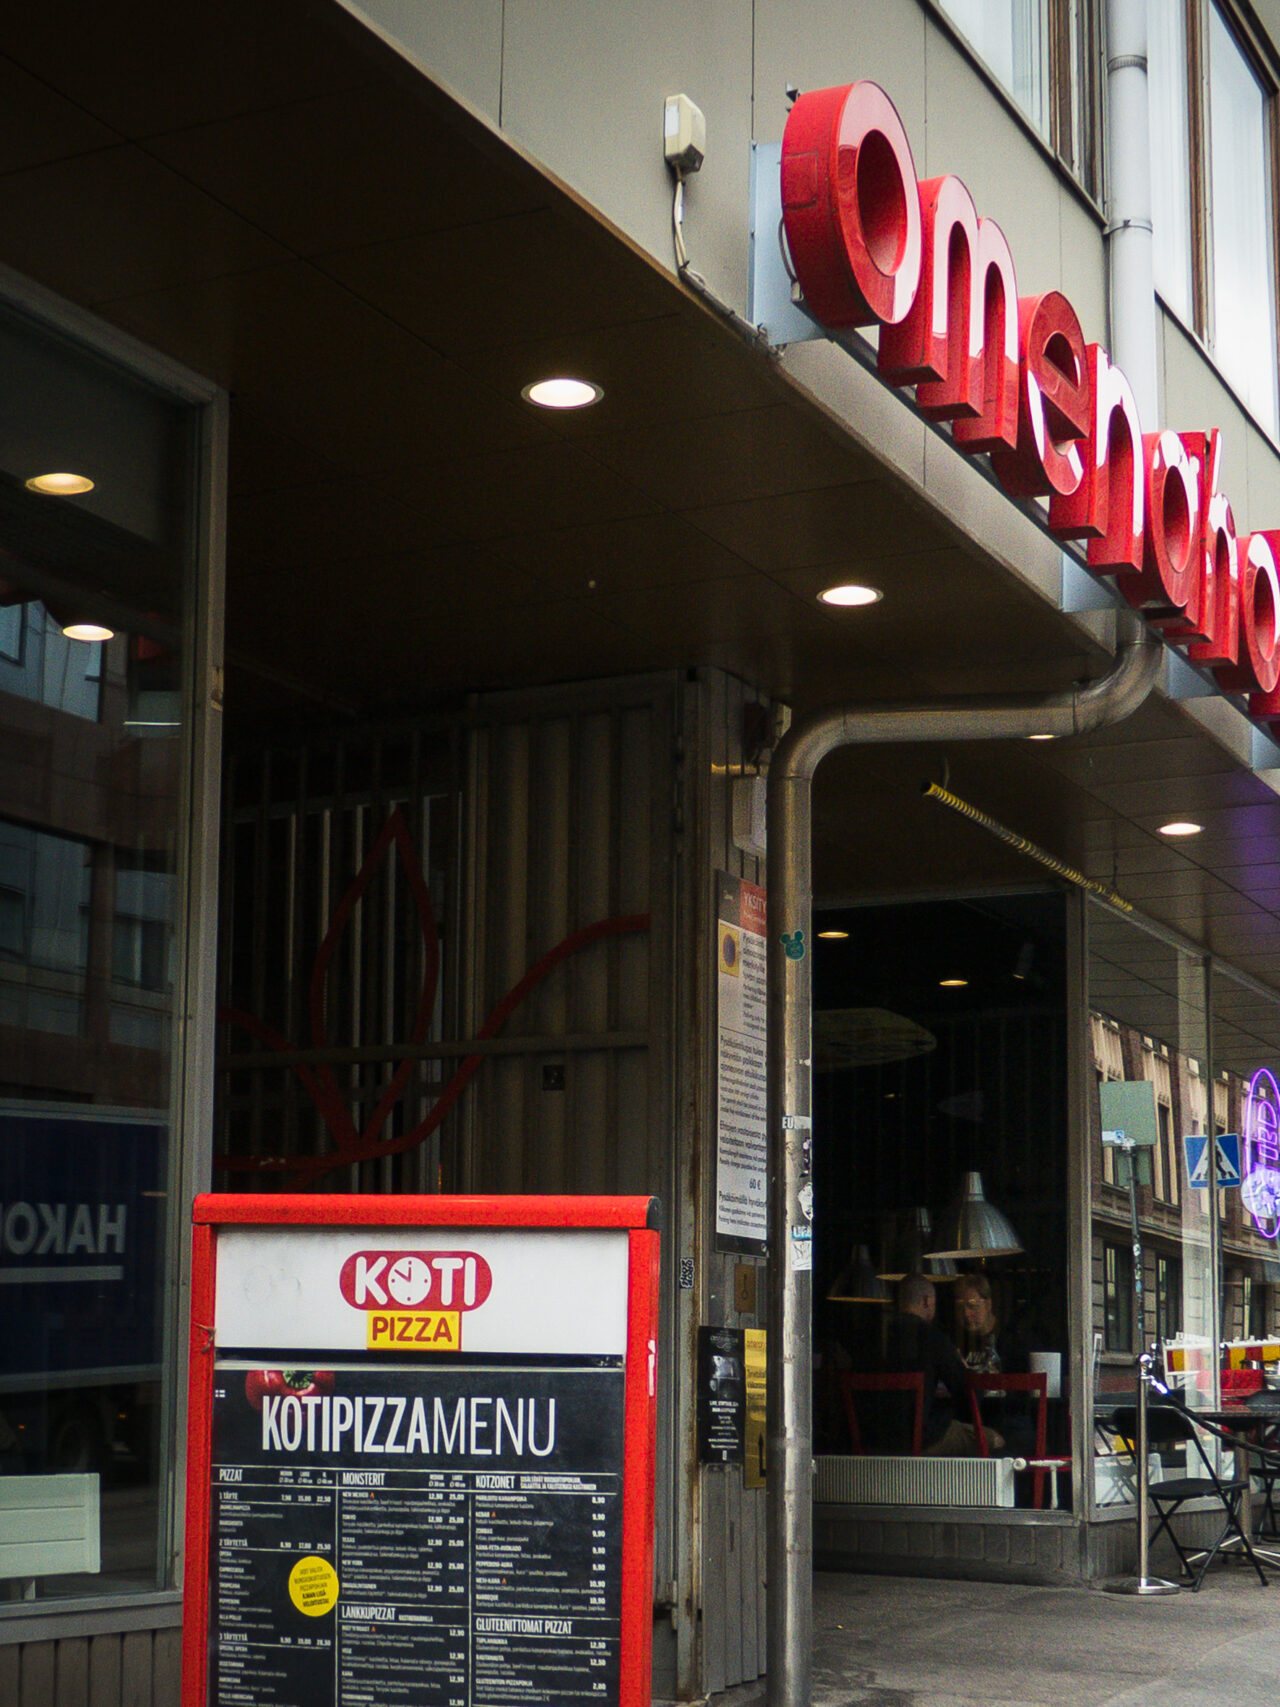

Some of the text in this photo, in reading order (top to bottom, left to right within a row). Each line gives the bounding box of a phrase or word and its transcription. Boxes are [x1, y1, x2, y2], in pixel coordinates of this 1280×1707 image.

[355, 1256, 476, 1306] KOTI
[372, 1316, 453, 1342] PIZZA
[219, 1469, 243, 1481] PIZZAT
[342, 1472, 385, 1485] MONSTERIT
[475, 1475, 515, 1489] KOTZONET
[342, 1605, 396, 1621] LANKKUPIZZAT
[475, 1617, 573, 1634] GLUTEENITTOMAT PIZZAT
